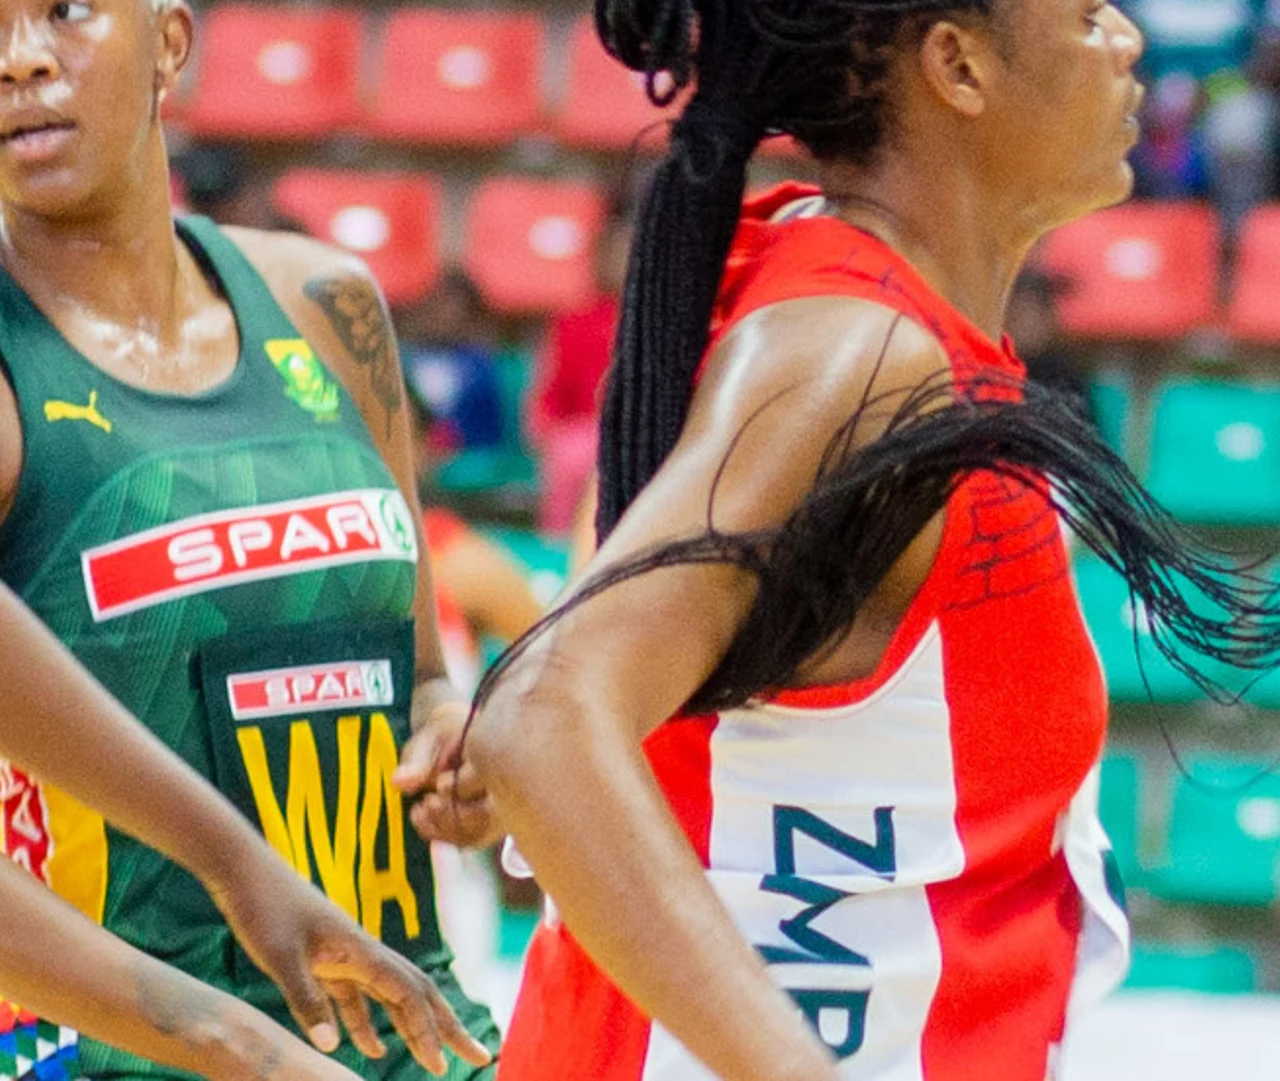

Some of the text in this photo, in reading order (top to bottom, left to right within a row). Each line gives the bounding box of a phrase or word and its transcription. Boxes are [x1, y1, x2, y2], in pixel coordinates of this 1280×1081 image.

[167, 502, 378, 582] SPAR
[264, 667, 366, 704] SPAR
[236, 712, 419, 940] WA
